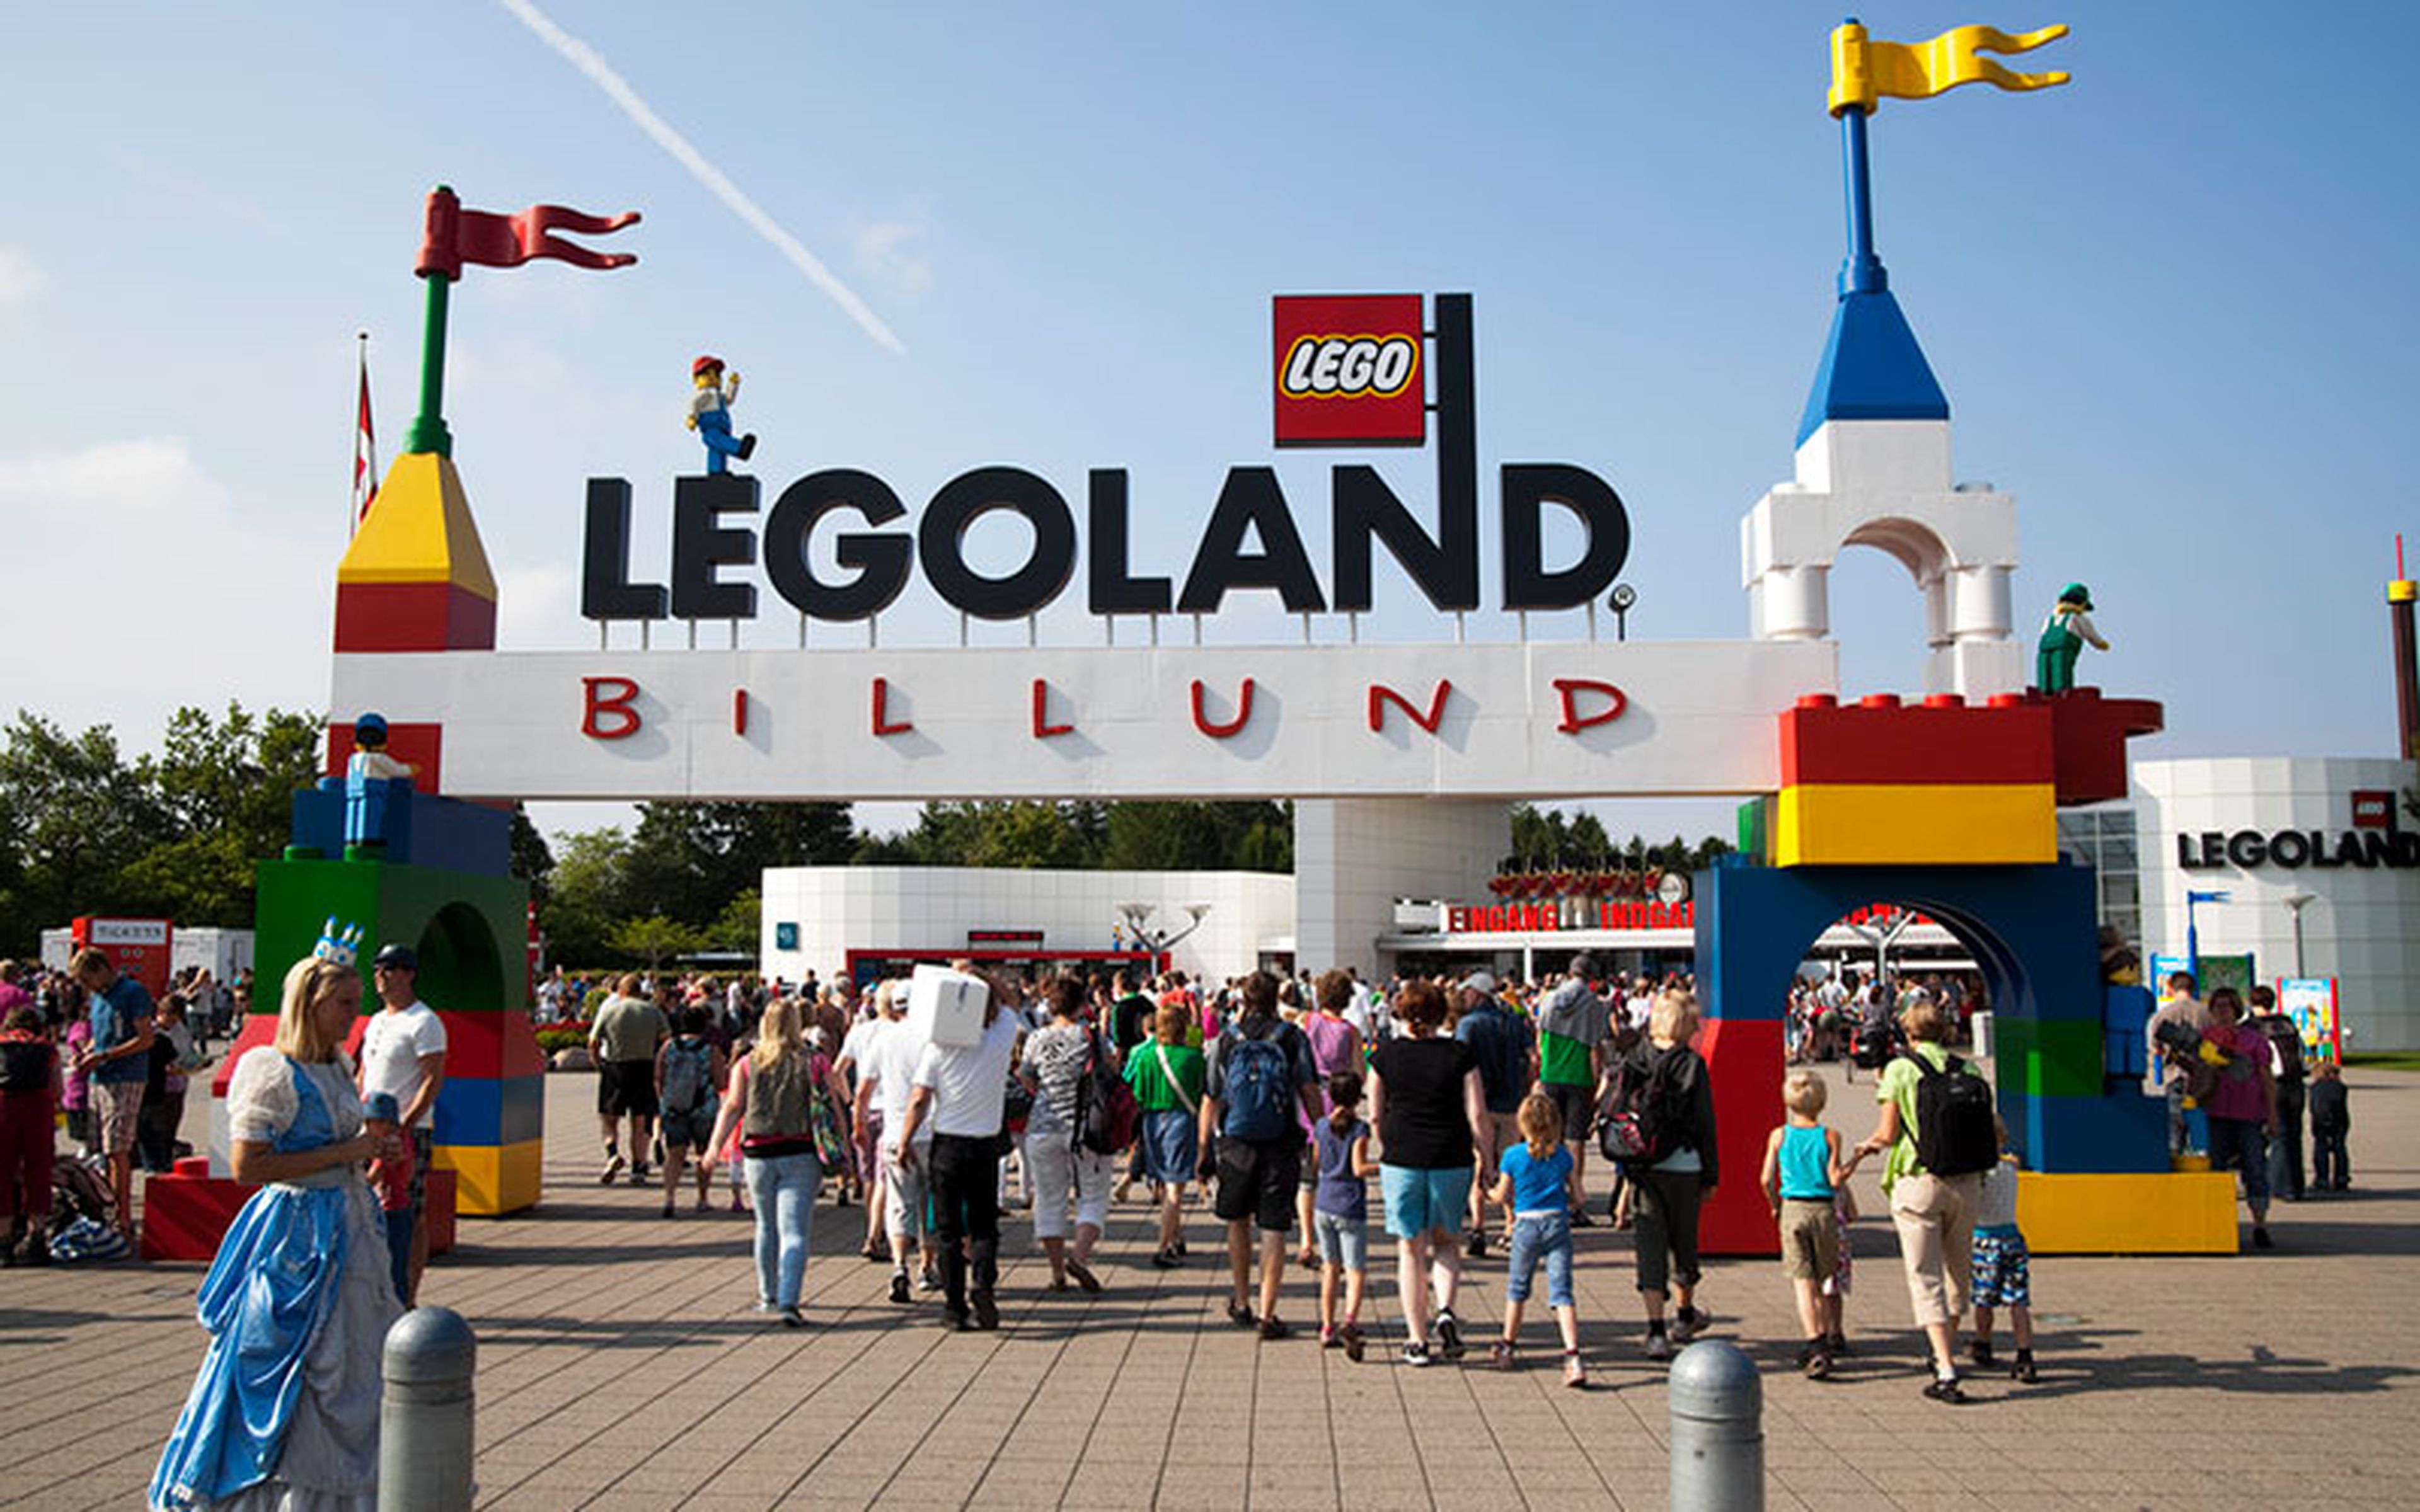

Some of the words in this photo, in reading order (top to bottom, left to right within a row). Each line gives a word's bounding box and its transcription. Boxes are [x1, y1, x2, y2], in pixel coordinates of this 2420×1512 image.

[1284, 337, 1415, 396] LEGO
[581, 677, 1627, 738] BILLUND
[1449, 903, 1558, 932] EINGANG
